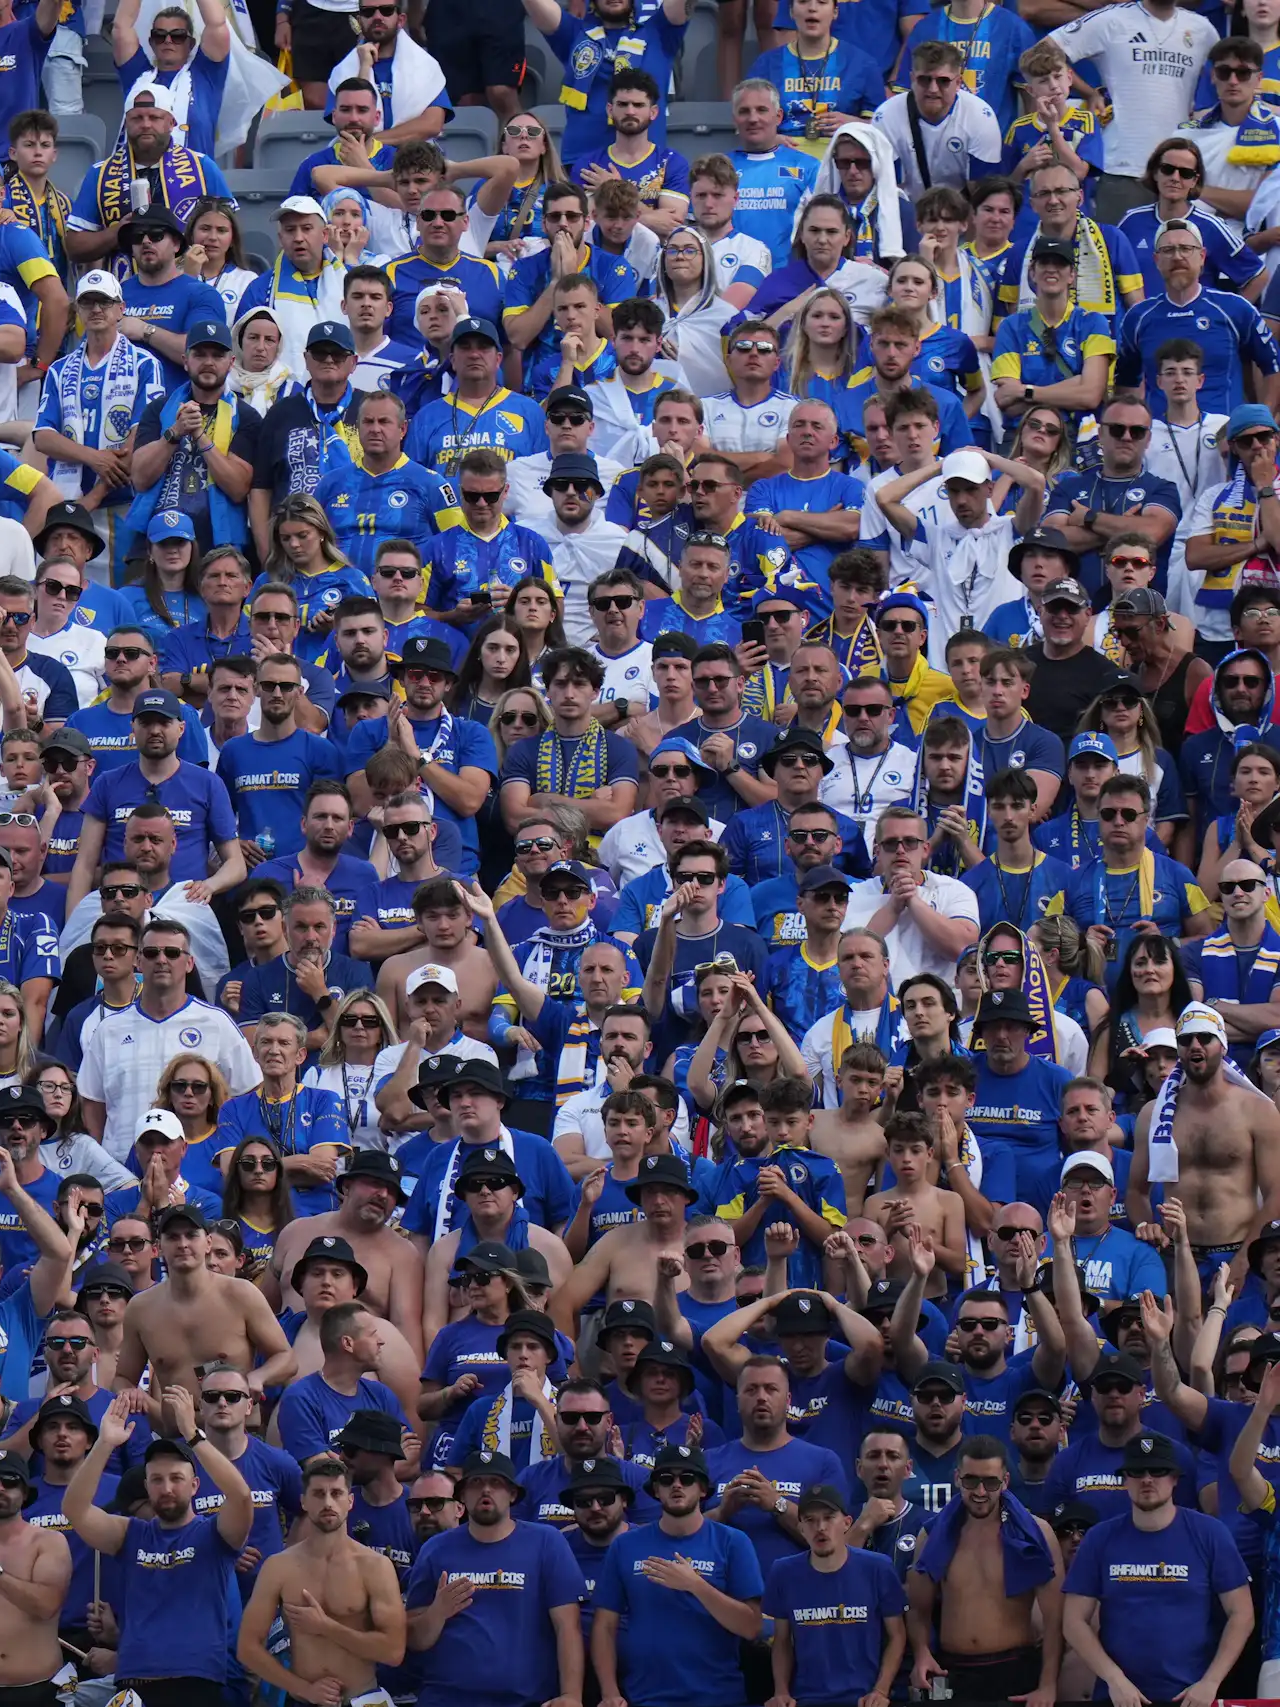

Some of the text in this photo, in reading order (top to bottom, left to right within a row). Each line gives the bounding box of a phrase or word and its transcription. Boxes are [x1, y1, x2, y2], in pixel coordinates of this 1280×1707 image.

[1133, 48, 1194, 67] Emirates
[1142, 64, 1186, 79] FLY BETTER
[740, 186, 784, 199] OSNIA AND
[735, 198, 787, 211] ERZEGOVINA
[357, 513, 376, 536] 11
[919, 505, 939, 526] 11
[550, 977, 575, 997] 20
[921, 1484, 951, 1513] 10
[1109, 1561, 1189, 1577] BHFANATICOS
[793, 1604, 868, 1622] BHFANATICOS
